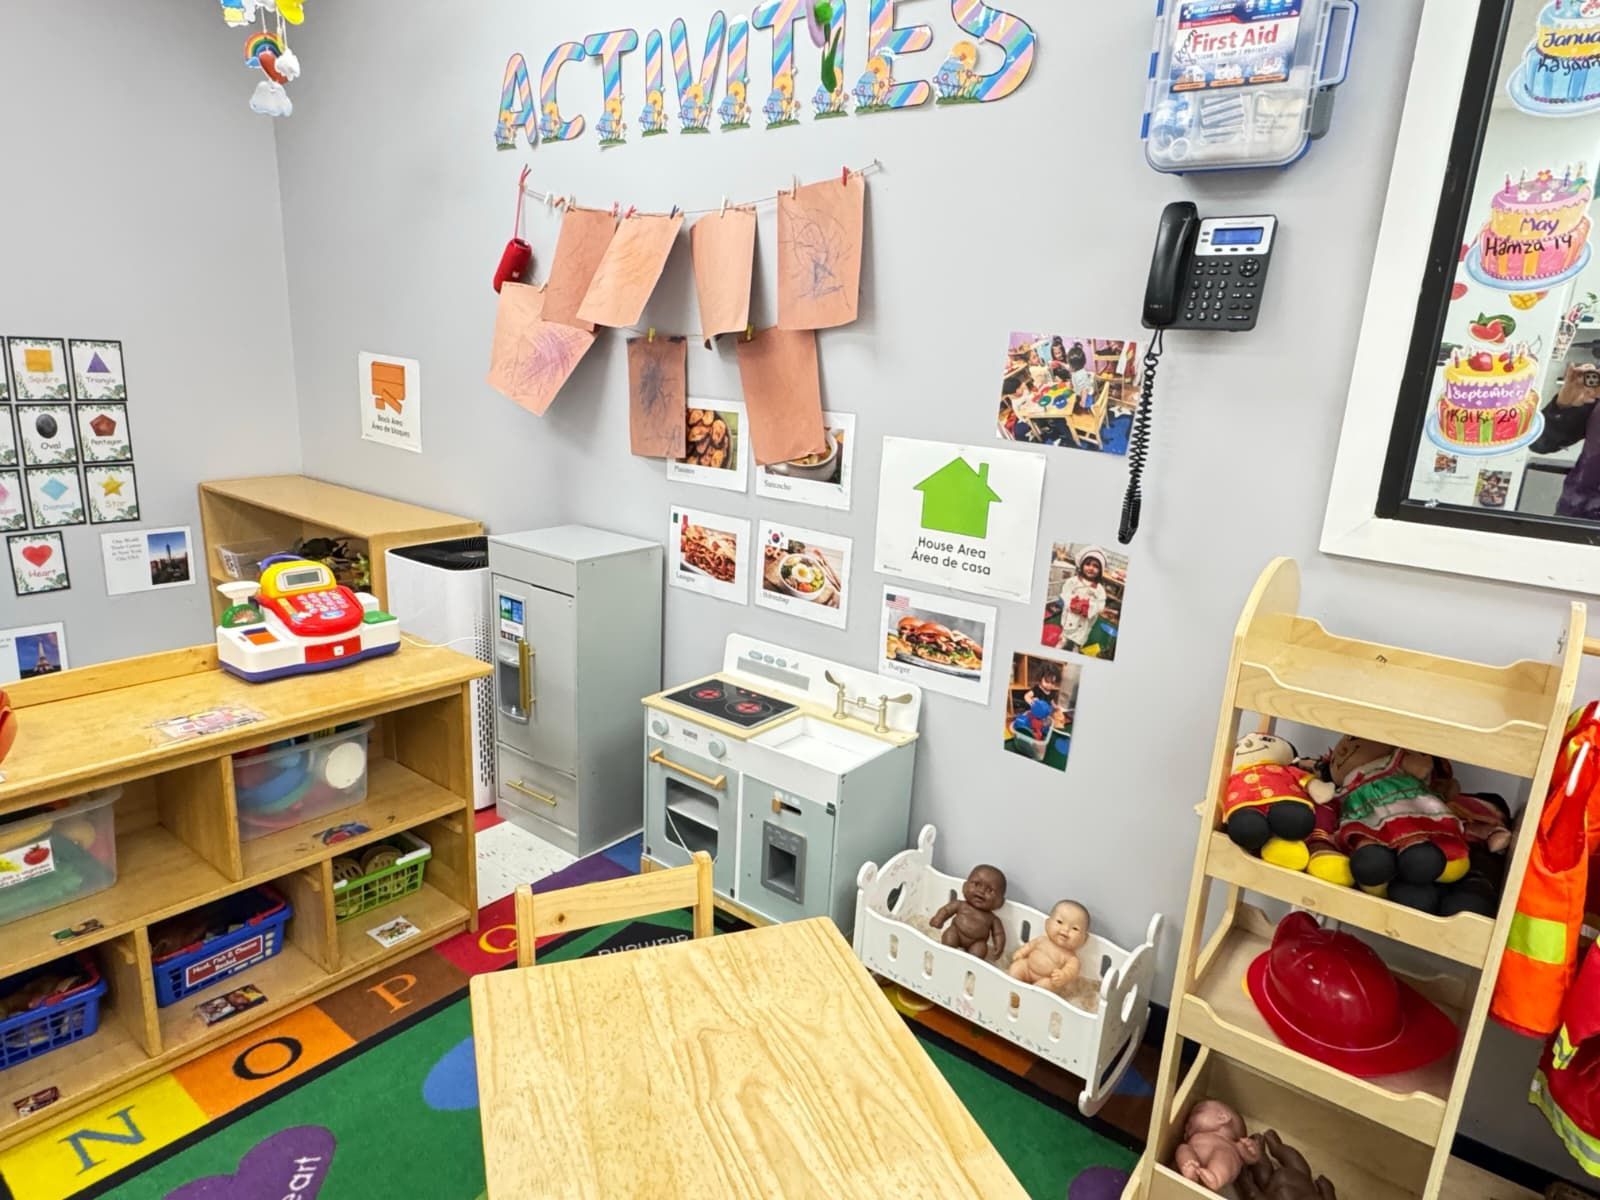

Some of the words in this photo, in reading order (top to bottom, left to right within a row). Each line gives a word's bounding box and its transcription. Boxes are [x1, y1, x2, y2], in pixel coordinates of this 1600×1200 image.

[1192, 31, 1238, 53] First
[1241, 24, 1279, 47] Aid
[495, 0, 1036, 150] ACTIVITIES
[1520, 217, 1560, 235] May
[1485, 236, 1545, 257] Hamza
[86, 376, 116, 385] Triangle
[1452, 386, 1525, 403] September
[41, 441, 61, 450] Oval
[91, 439, 122, 447] Pentagon
[105, 500, 127, 508] Star
[918, 536, 954, 552] House
[957, 544, 986, 559] Area
[911, 547, 939, 565] Área
[942, 556, 958, 568] de
[961, 562, 991, 576] casa
[28, 569, 56, 578] Heart
[57, 1104, 145, 1176] N
[232, 1036, 303, 1080] O
[367, 973, 417, 1014] P
